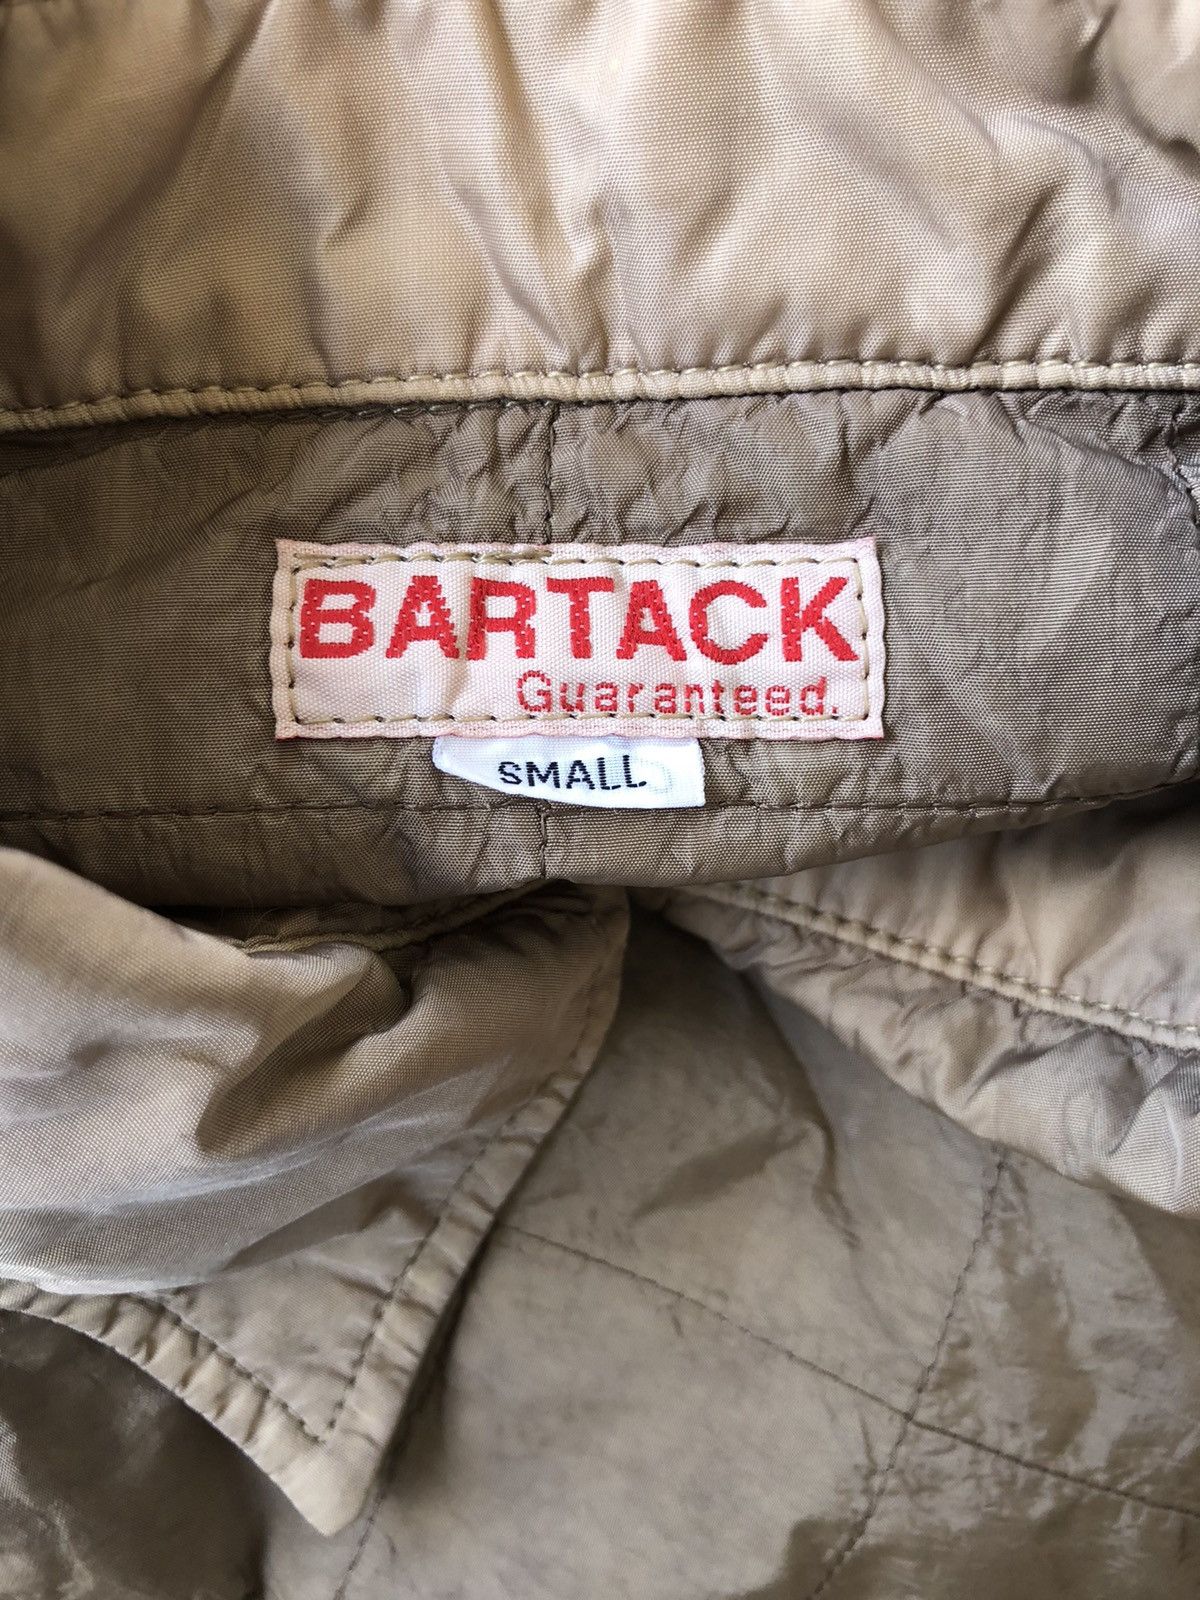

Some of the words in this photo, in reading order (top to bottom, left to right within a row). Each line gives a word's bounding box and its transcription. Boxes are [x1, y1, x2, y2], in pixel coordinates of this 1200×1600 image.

[299, 575, 859, 665] BARTACK
[516, 670, 839, 717] Guaranteed.
[498, 754, 648, 790] SMALL
